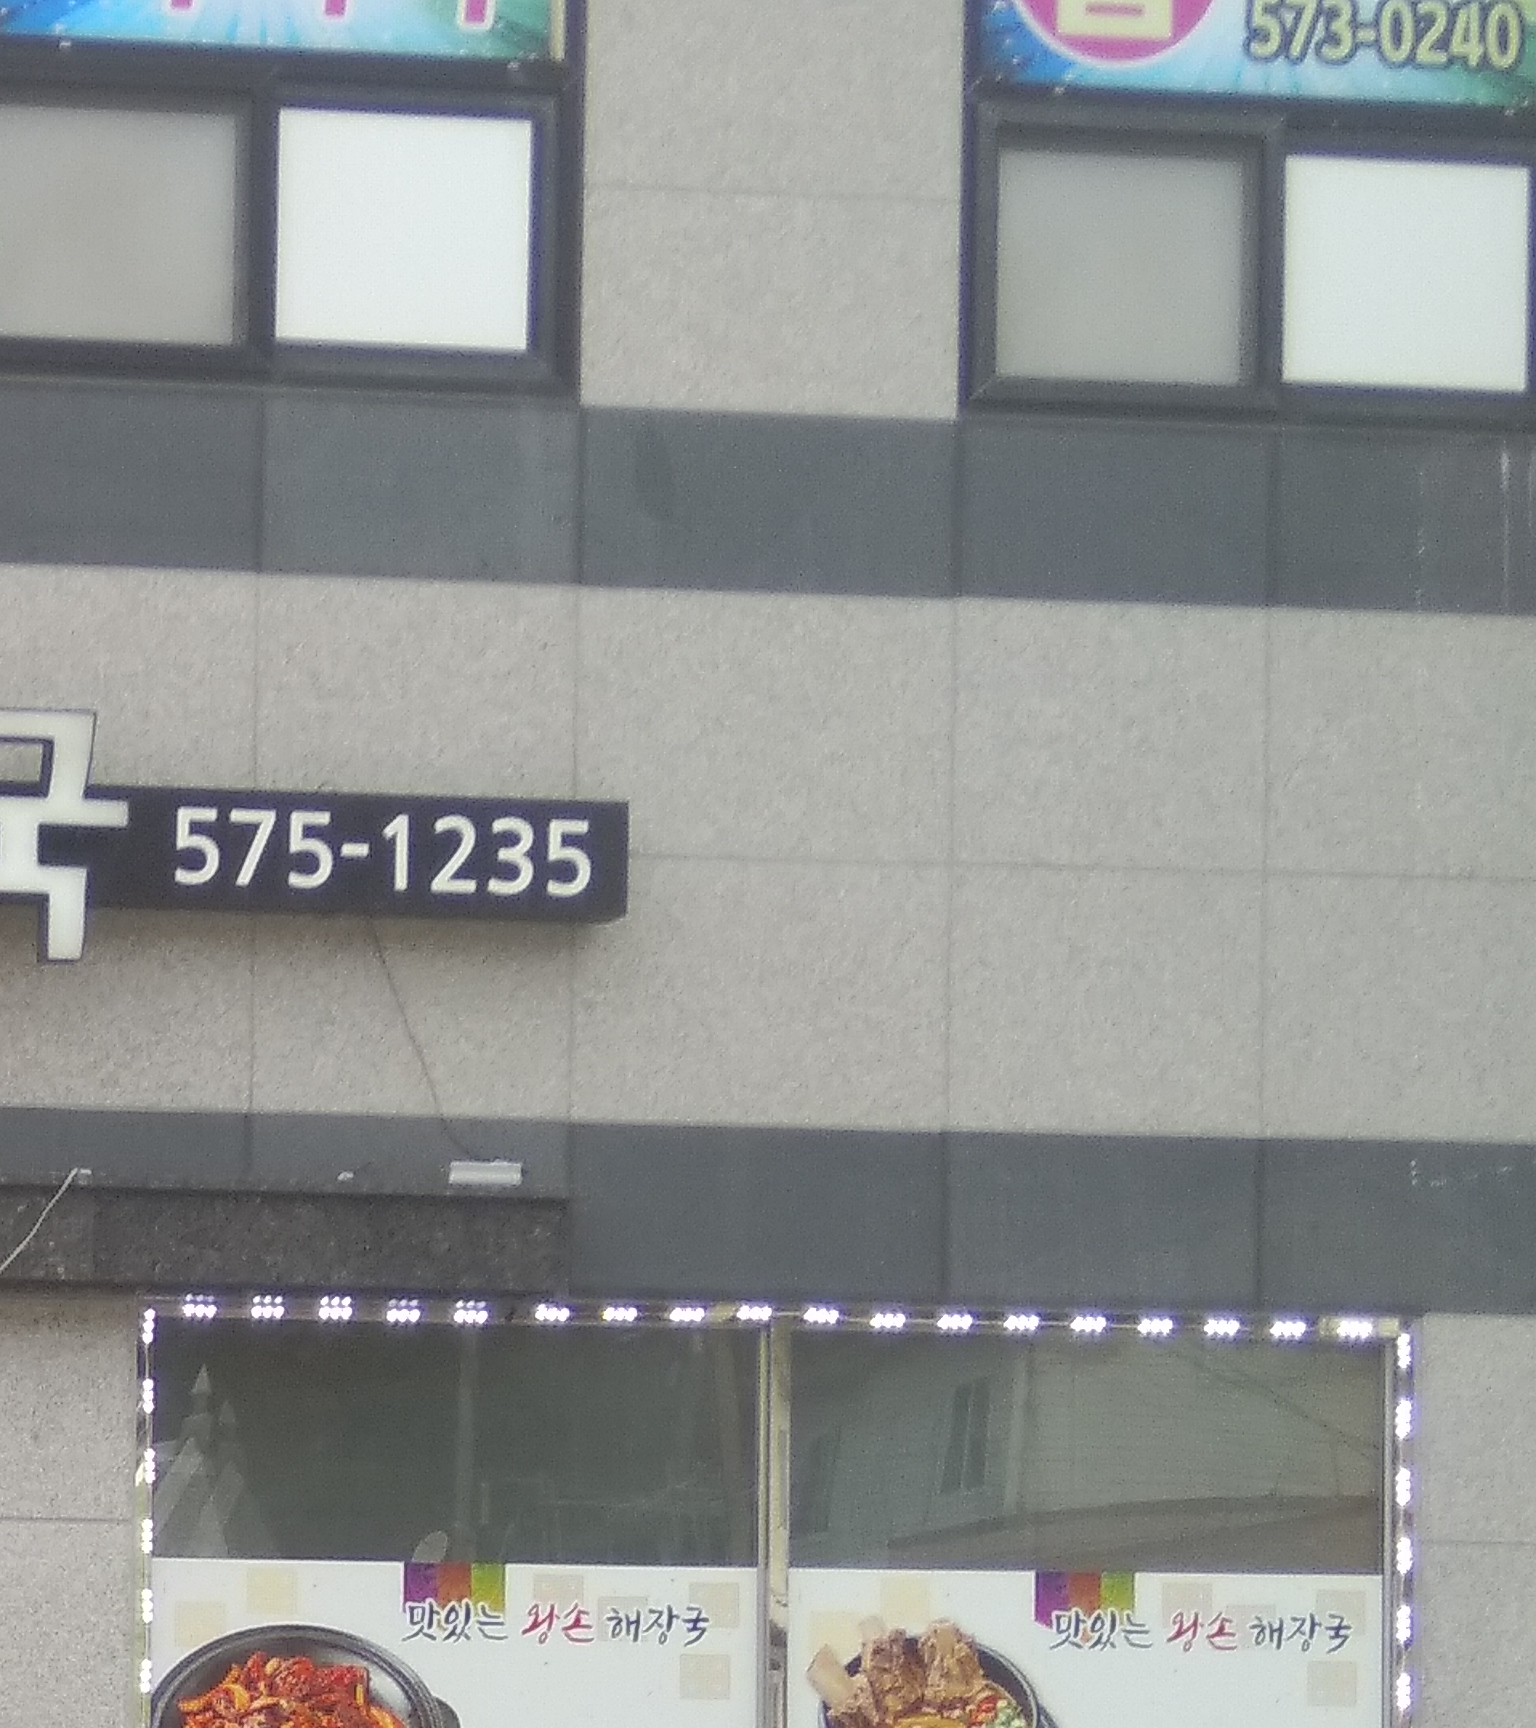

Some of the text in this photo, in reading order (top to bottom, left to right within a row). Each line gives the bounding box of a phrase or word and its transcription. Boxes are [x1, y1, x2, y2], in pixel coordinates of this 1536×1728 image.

[1245, 0, 1524, 70] 573-0240
[173, 806, 593, 898] 575-1235
[401, 1600, 710, 1645] 맛있는 왕손 해장국
[1047, 1609, 1353, 1654] 맛있는 왕손 해장국
